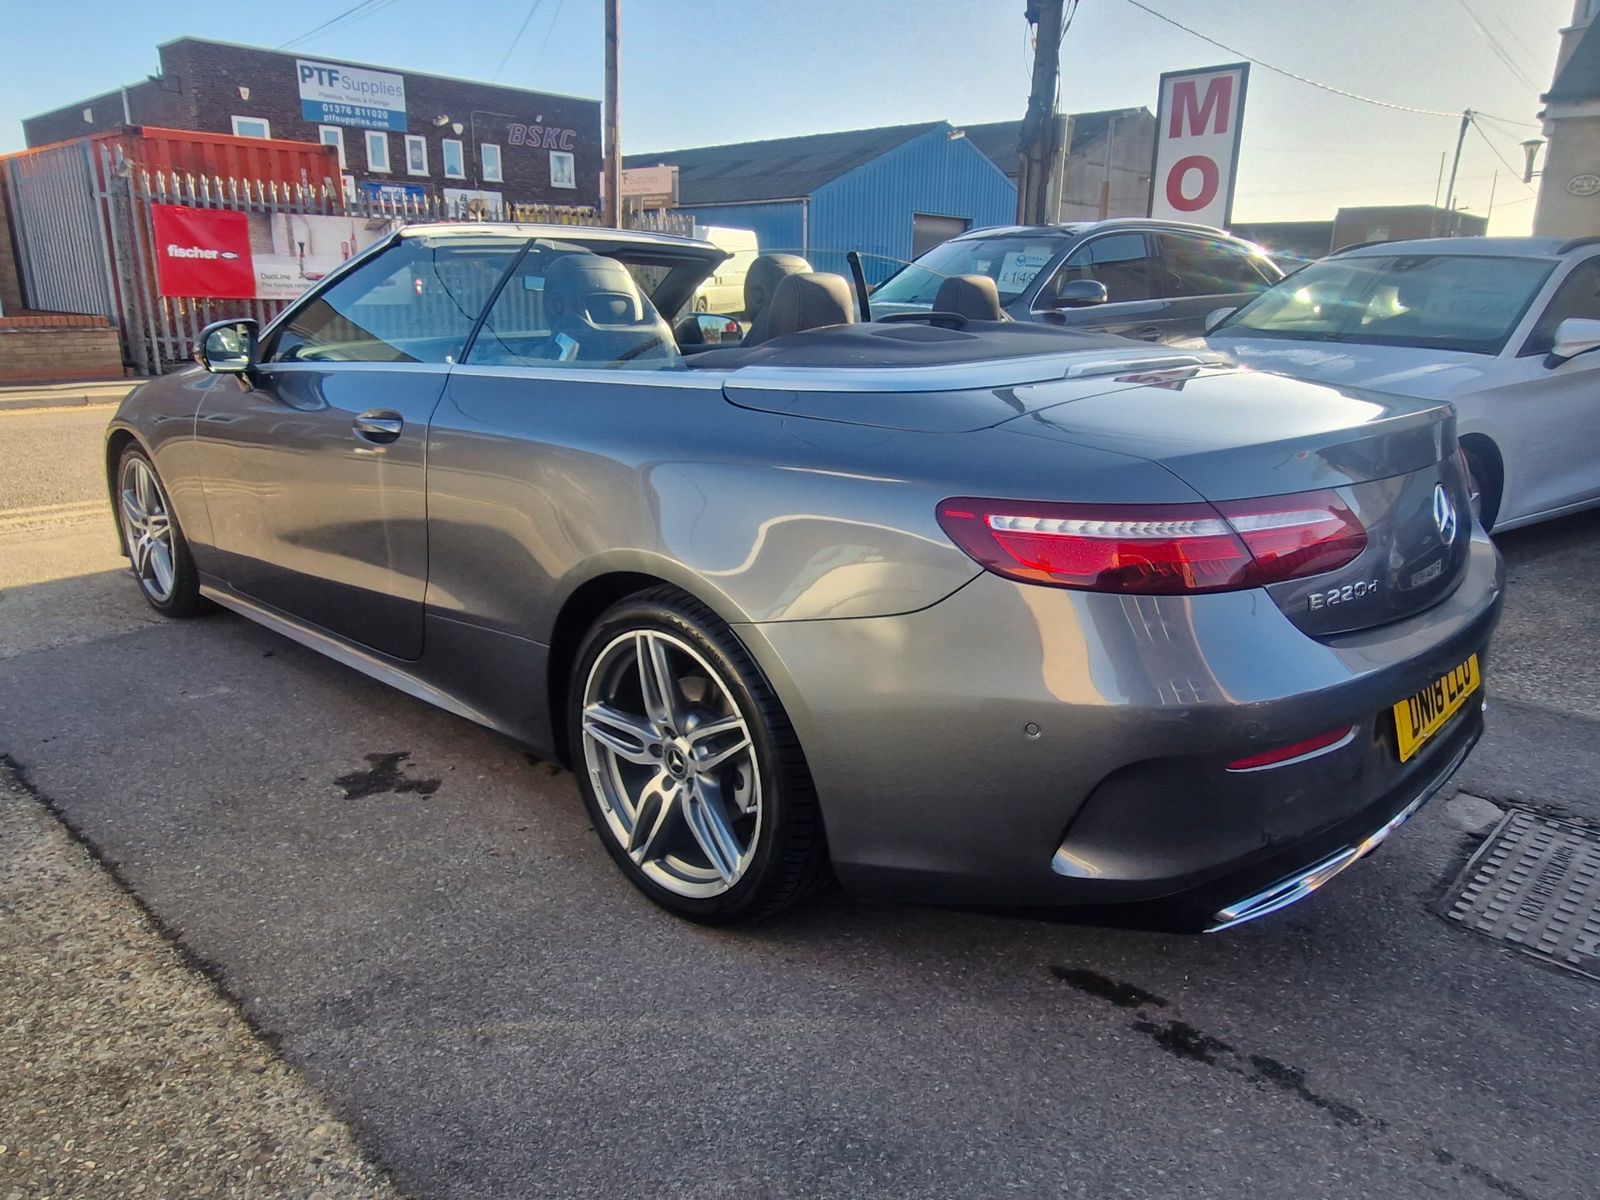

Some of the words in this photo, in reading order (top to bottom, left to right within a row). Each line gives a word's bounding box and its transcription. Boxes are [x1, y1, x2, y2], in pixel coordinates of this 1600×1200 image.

[300, 65, 340, 87] PTF
[341, 75, 403, 97] Supplies
[322, 103, 352, 115] 01376
[355, 106, 388, 119] 811020
[323, 115, 389, 128] ptfsupplies.com
[507, 123, 577, 150] BSKC
[167, 244, 218, 259] fischer
[260, 272, 291, 280] DuoLine
